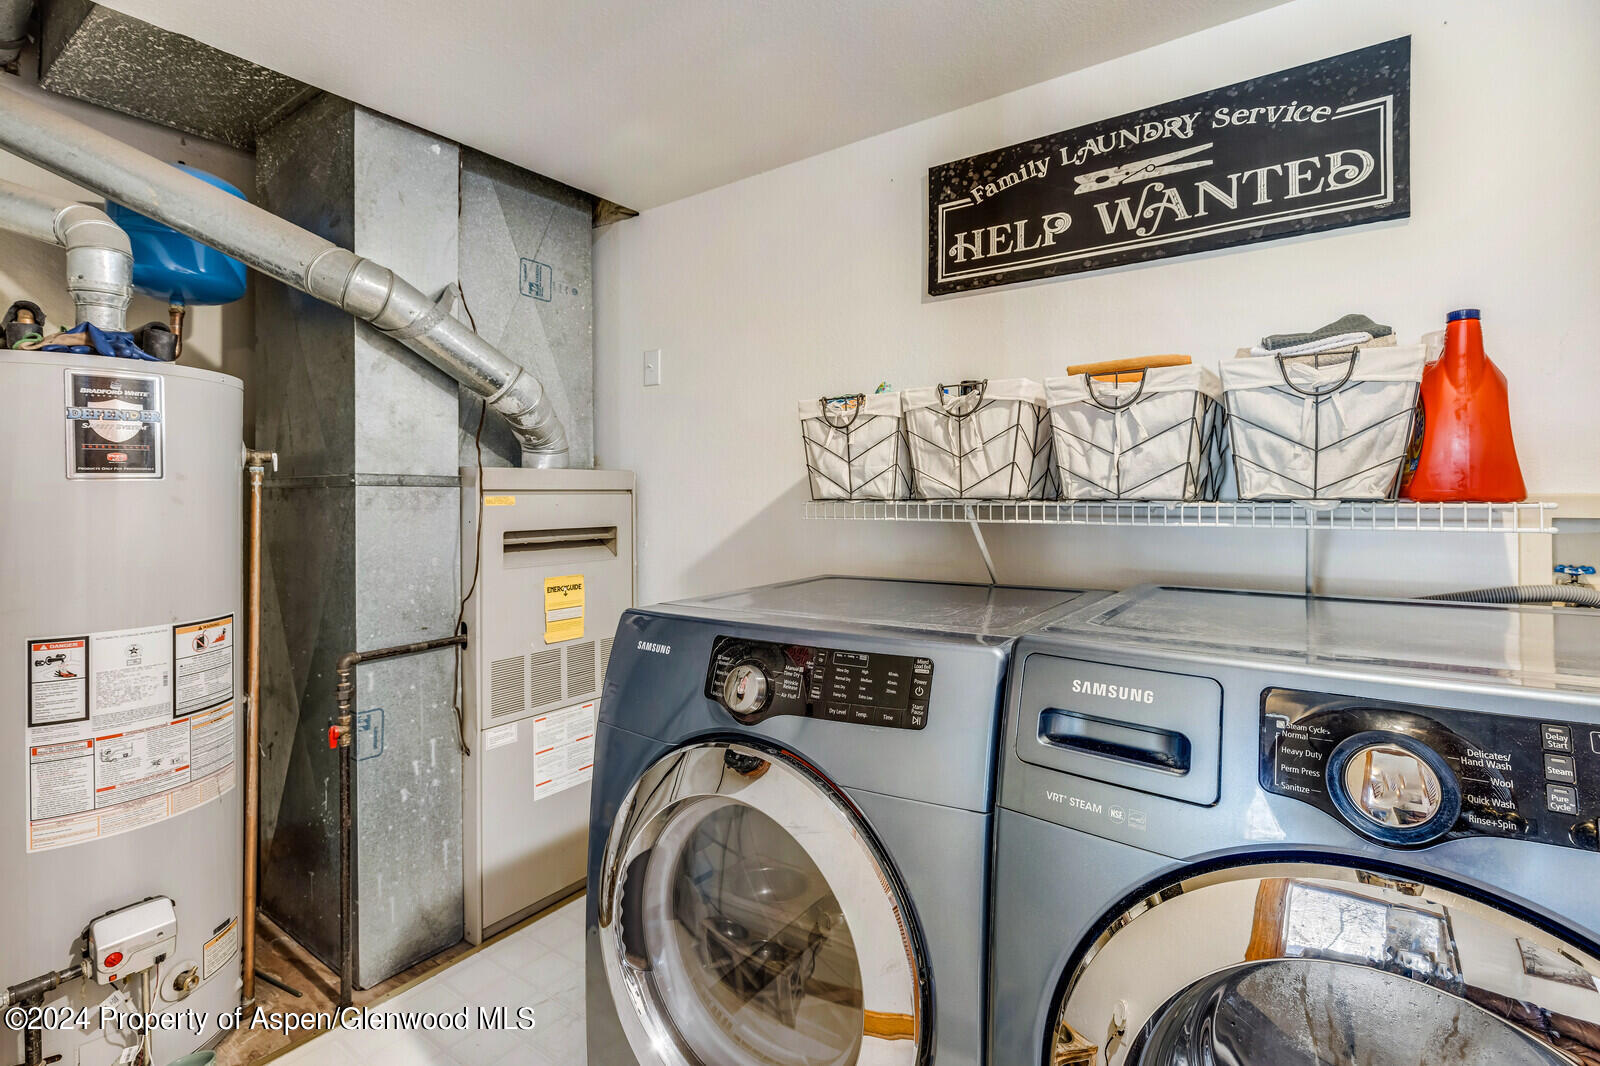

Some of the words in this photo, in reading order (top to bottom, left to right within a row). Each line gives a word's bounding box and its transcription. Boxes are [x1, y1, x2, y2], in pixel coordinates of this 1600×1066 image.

[972, 156, 1051, 204] Family
[1060, 112, 1202, 166] LAUNDRY
[1212, 100, 1332, 129] Service
[948, 212, 1073, 264] HELP
[1094, 148, 1375, 237] WANTED
[67, 407, 160, 422] DEFENDER
[638, 641, 670, 654] SAMSUNG
[1072, 679, 1155, 704] SAMSUNG
[1282, 730, 1308, 740] Normal
[1546, 733, 1568, 742] Delay
[1548, 741, 1568, 749] Start
[1281, 747, 1303, 757] Heavy
[1305, 750, 1322, 760] Duty
[1467, 749, 1511, 761] Delicates/
[1461, 756, 1483, 767] Hand
[1486, 760, 1512, 771] Wash
[1281, 764, 1300, 774] Perm
[1302, 768, 1320, 777] Press
[1547, 766, 1573, 777] Steam
[1281, 782, 1310, 793] Sanitize
[1491, 778, 1513, 788] Wool
[1468, 794, 1490, 806] Quick
[1491, 798, 1516, 809] Wash
[1551, 794, 1569, 803] Pure
[1069, 797, 1102, 814] STEAM
[1469, 814, 1516, 830] Rinse+Spin
